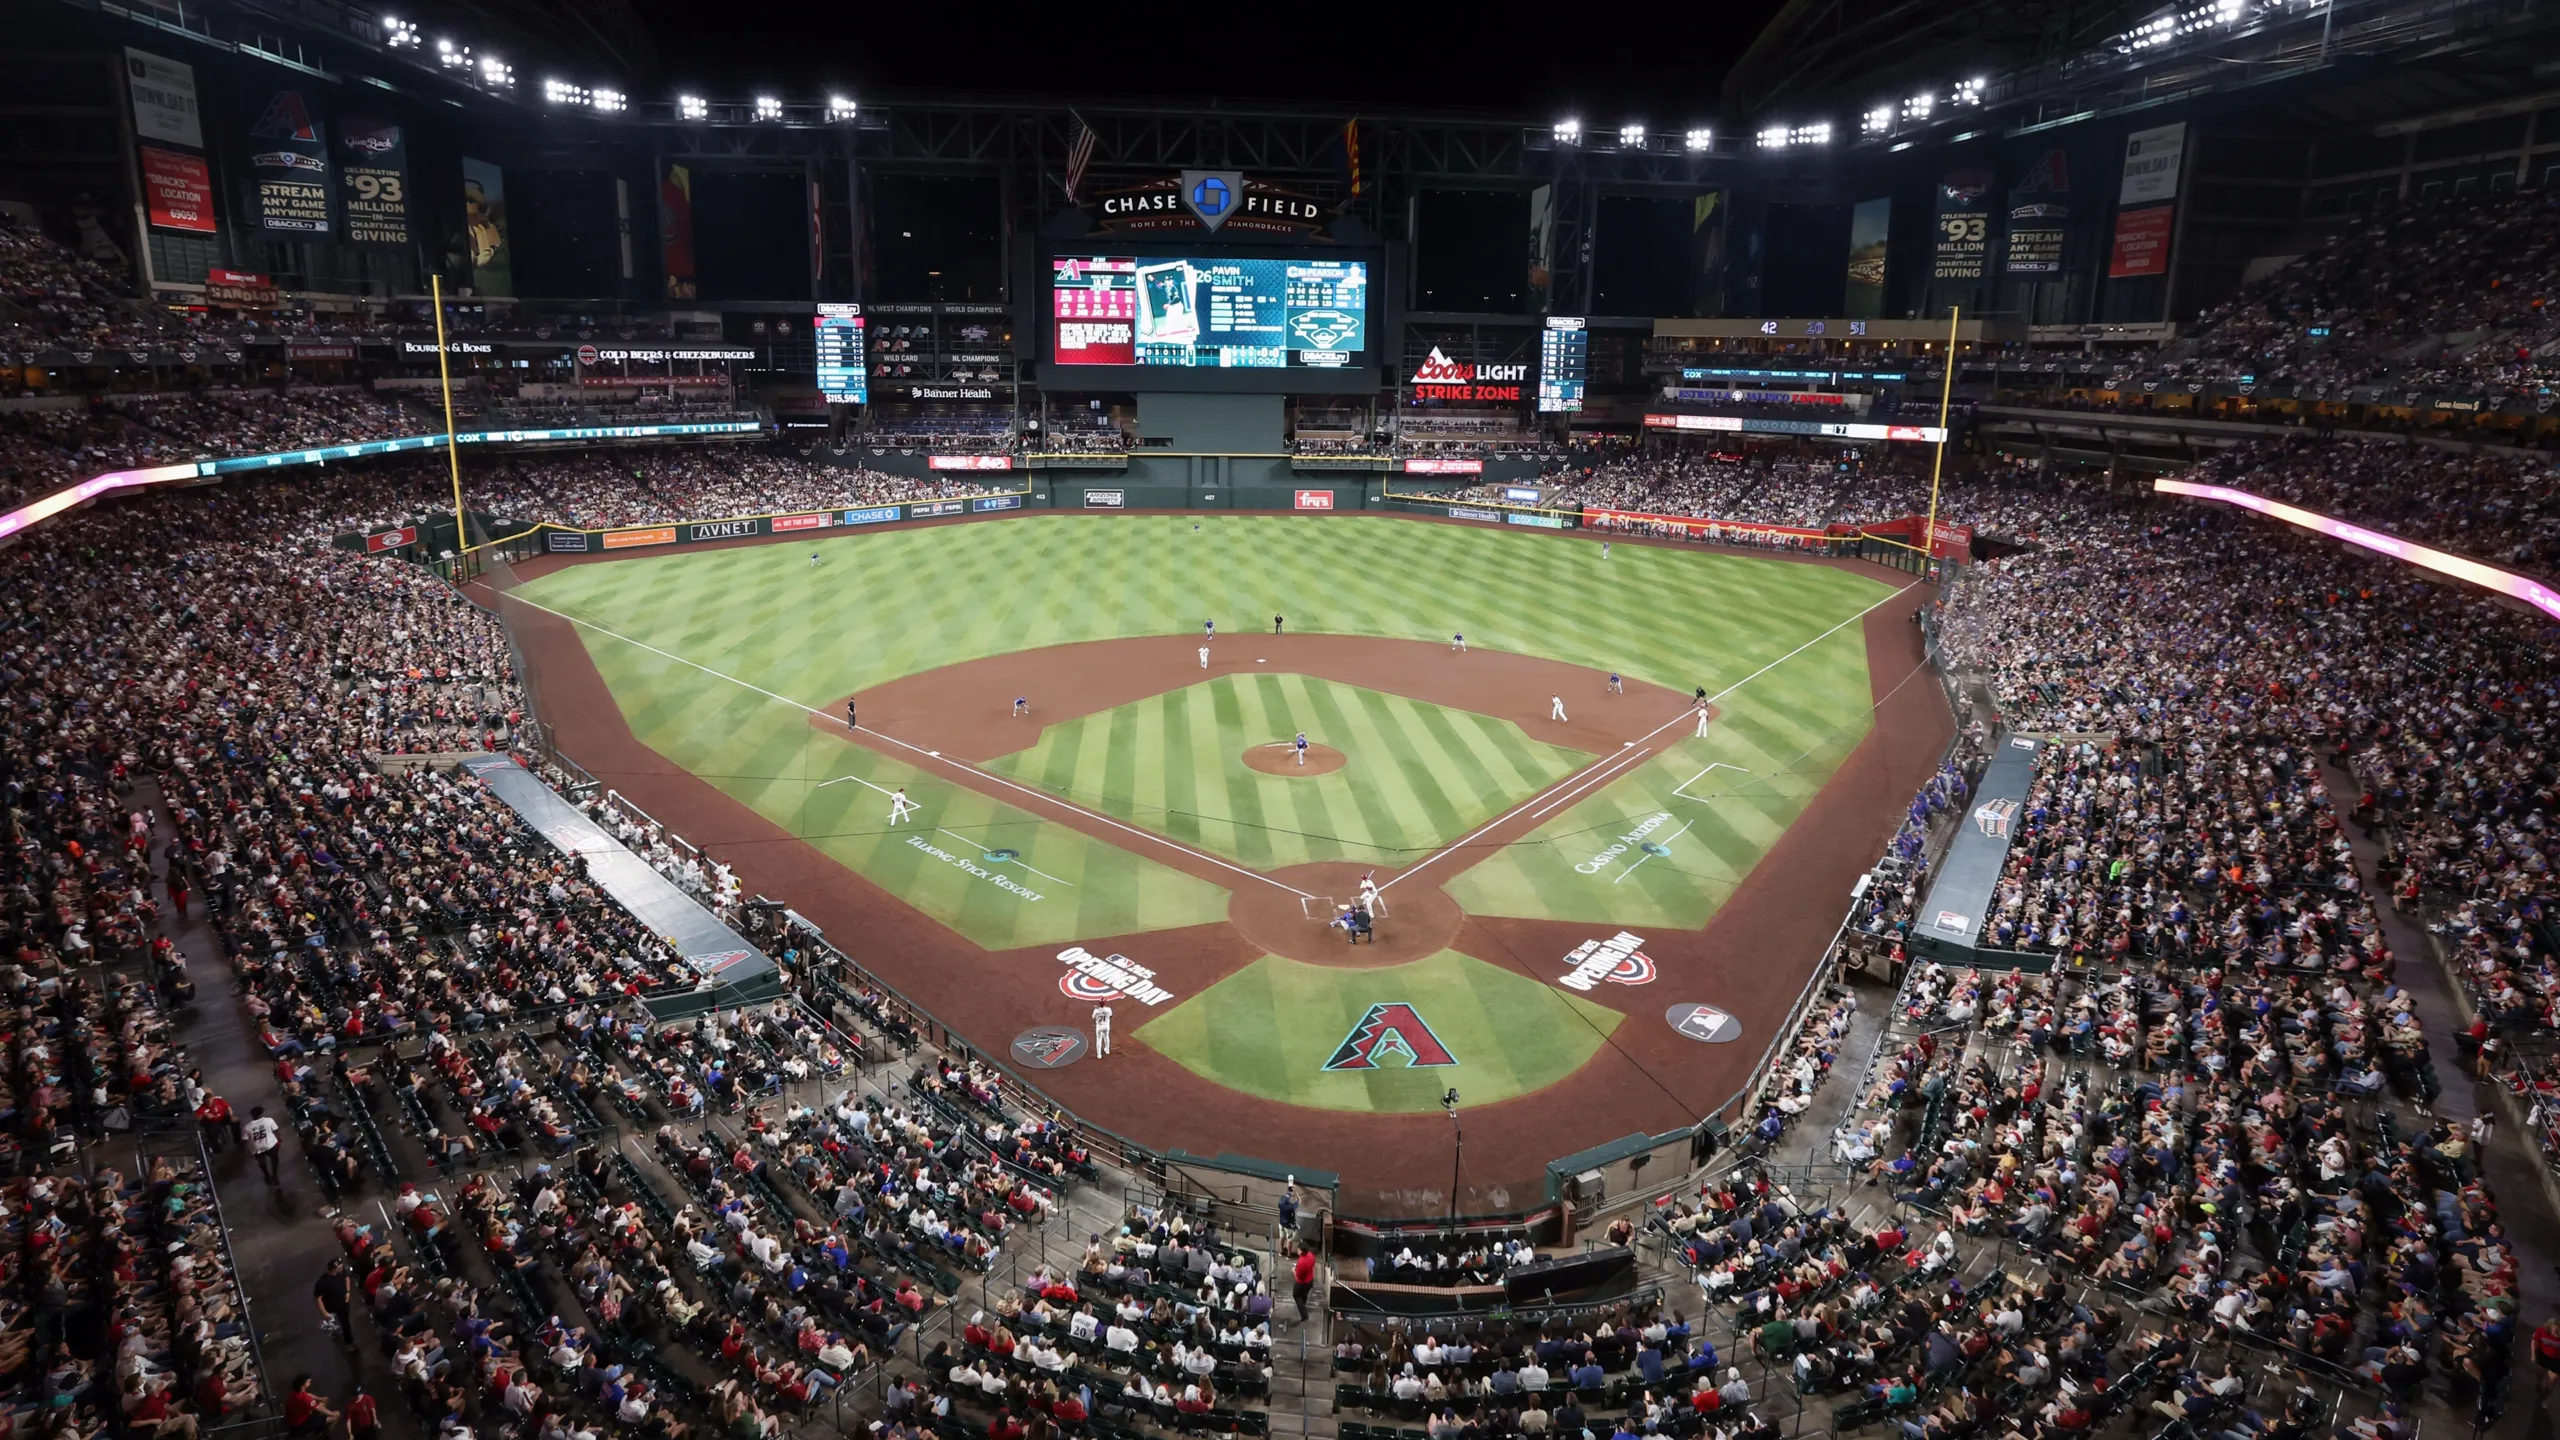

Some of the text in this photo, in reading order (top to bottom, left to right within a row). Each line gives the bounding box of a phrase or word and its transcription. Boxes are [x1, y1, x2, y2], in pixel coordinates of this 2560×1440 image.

[344, 167, 400, 177] CELEBRATING
[260, 185, 324, 199] STREAM
[345, 175, 403, 202] $93
[160, 188, 201, 202] LOCATION
[262, 198, 326, 210] ANY GAME
[347, 201, 404, 213] MILLION
[1104, 194, 1318, 219] CHASE FIELD
[170, 209, 197, 221] 69050
[263, 208, 327, 219] ANYWHERE
[1940, 212, 1988, 220] CELEBRATING
[268, 219, 315, 229] DBACKS.TV
[350, 221, 406, 230] CHARITABLE
[1227, 220, 1292, 232] DIAMONDBACKS
[351, 230, 408, 243] GIVING
[1940, 219, 1986, 242] $93
[2011, 233, 2064, 243] STREAM
[1937, 242, 1985, 252] MILLION
[2009, 243, 2062, 252] ANY GAME
[2122, 240, 2158, 252] LOCATION
[1935, 259, 1982, 267] CHARITABLE
[2008, 253, 2060, 261] ANYWHERE
[1089, 262, 1112, 270] SMITH
[1212, 266, 1240, 276] PAVIN
[1195, 270, 1212, 283] 26
[1307, 268, 1344, 277] PEARSON
[1934, 268, 1981, 278] GIVING
[1212, 275, 1254, 286] SMITH
[210, 286, 277, 302] SANDLOT
[1760, 321, 1866, 335] 42 20 51
[451, 345, 462, 353] &
[463, 343, 491, 354] BONES
[600, 350, 756, 360] COLD BEERS & CHEESEBURGERS
[1415, 356, 1527, 380] Coors LIGHT
[825, 394, 860, 403] $115,596
[923, 388, 991, 399] Banner Health
[1415, 384, 1520, 401] STRIKE ZONE
[1678, 389, 1731, 400] ESTRELLA
[1744, 391, 1790, 402] JALISCO
[456, 433, 480, 443] COX
[1298, 492, 1330, 508] fry's
[851, 510, 884, 521] CHASE
[1458, 511, 1497, 520] Banner Health
[1514, 515, 1556, 527] COX COX
[699, 522, 751, 538] AVNET
[1562, 520, 1573, 528] 374
[1574, 812, 1674, 874] CASINO ARIZONA
[905, 835, 1045, 902] TALKING STICK RESORT
[1558, 930, 1646, 991] OPENING DAY
[1056, 946, 1175, 1007] OPENING DAY
[1127, 964, 1157, 979] 2025
[1074, 1325, 1087, 1338] 20
